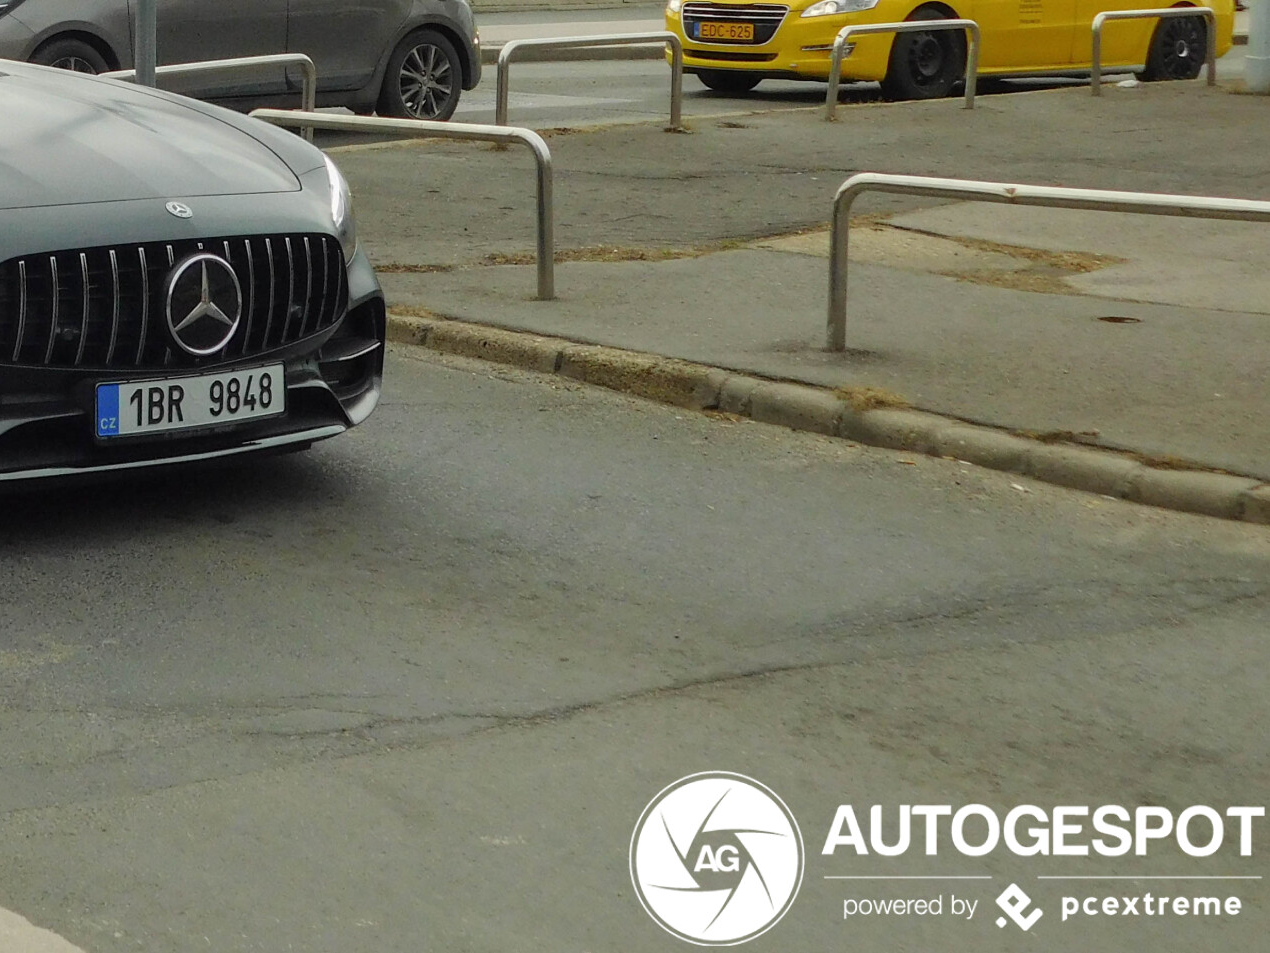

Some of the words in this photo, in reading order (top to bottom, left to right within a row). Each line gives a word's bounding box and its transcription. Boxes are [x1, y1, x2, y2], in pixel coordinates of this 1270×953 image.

[701, 24, 751, 38] EDC-625
[130, 385, 185, 427] 1BR
[209, 372, 272, 417] 9848
[100, 417, 116, 430] CZ
